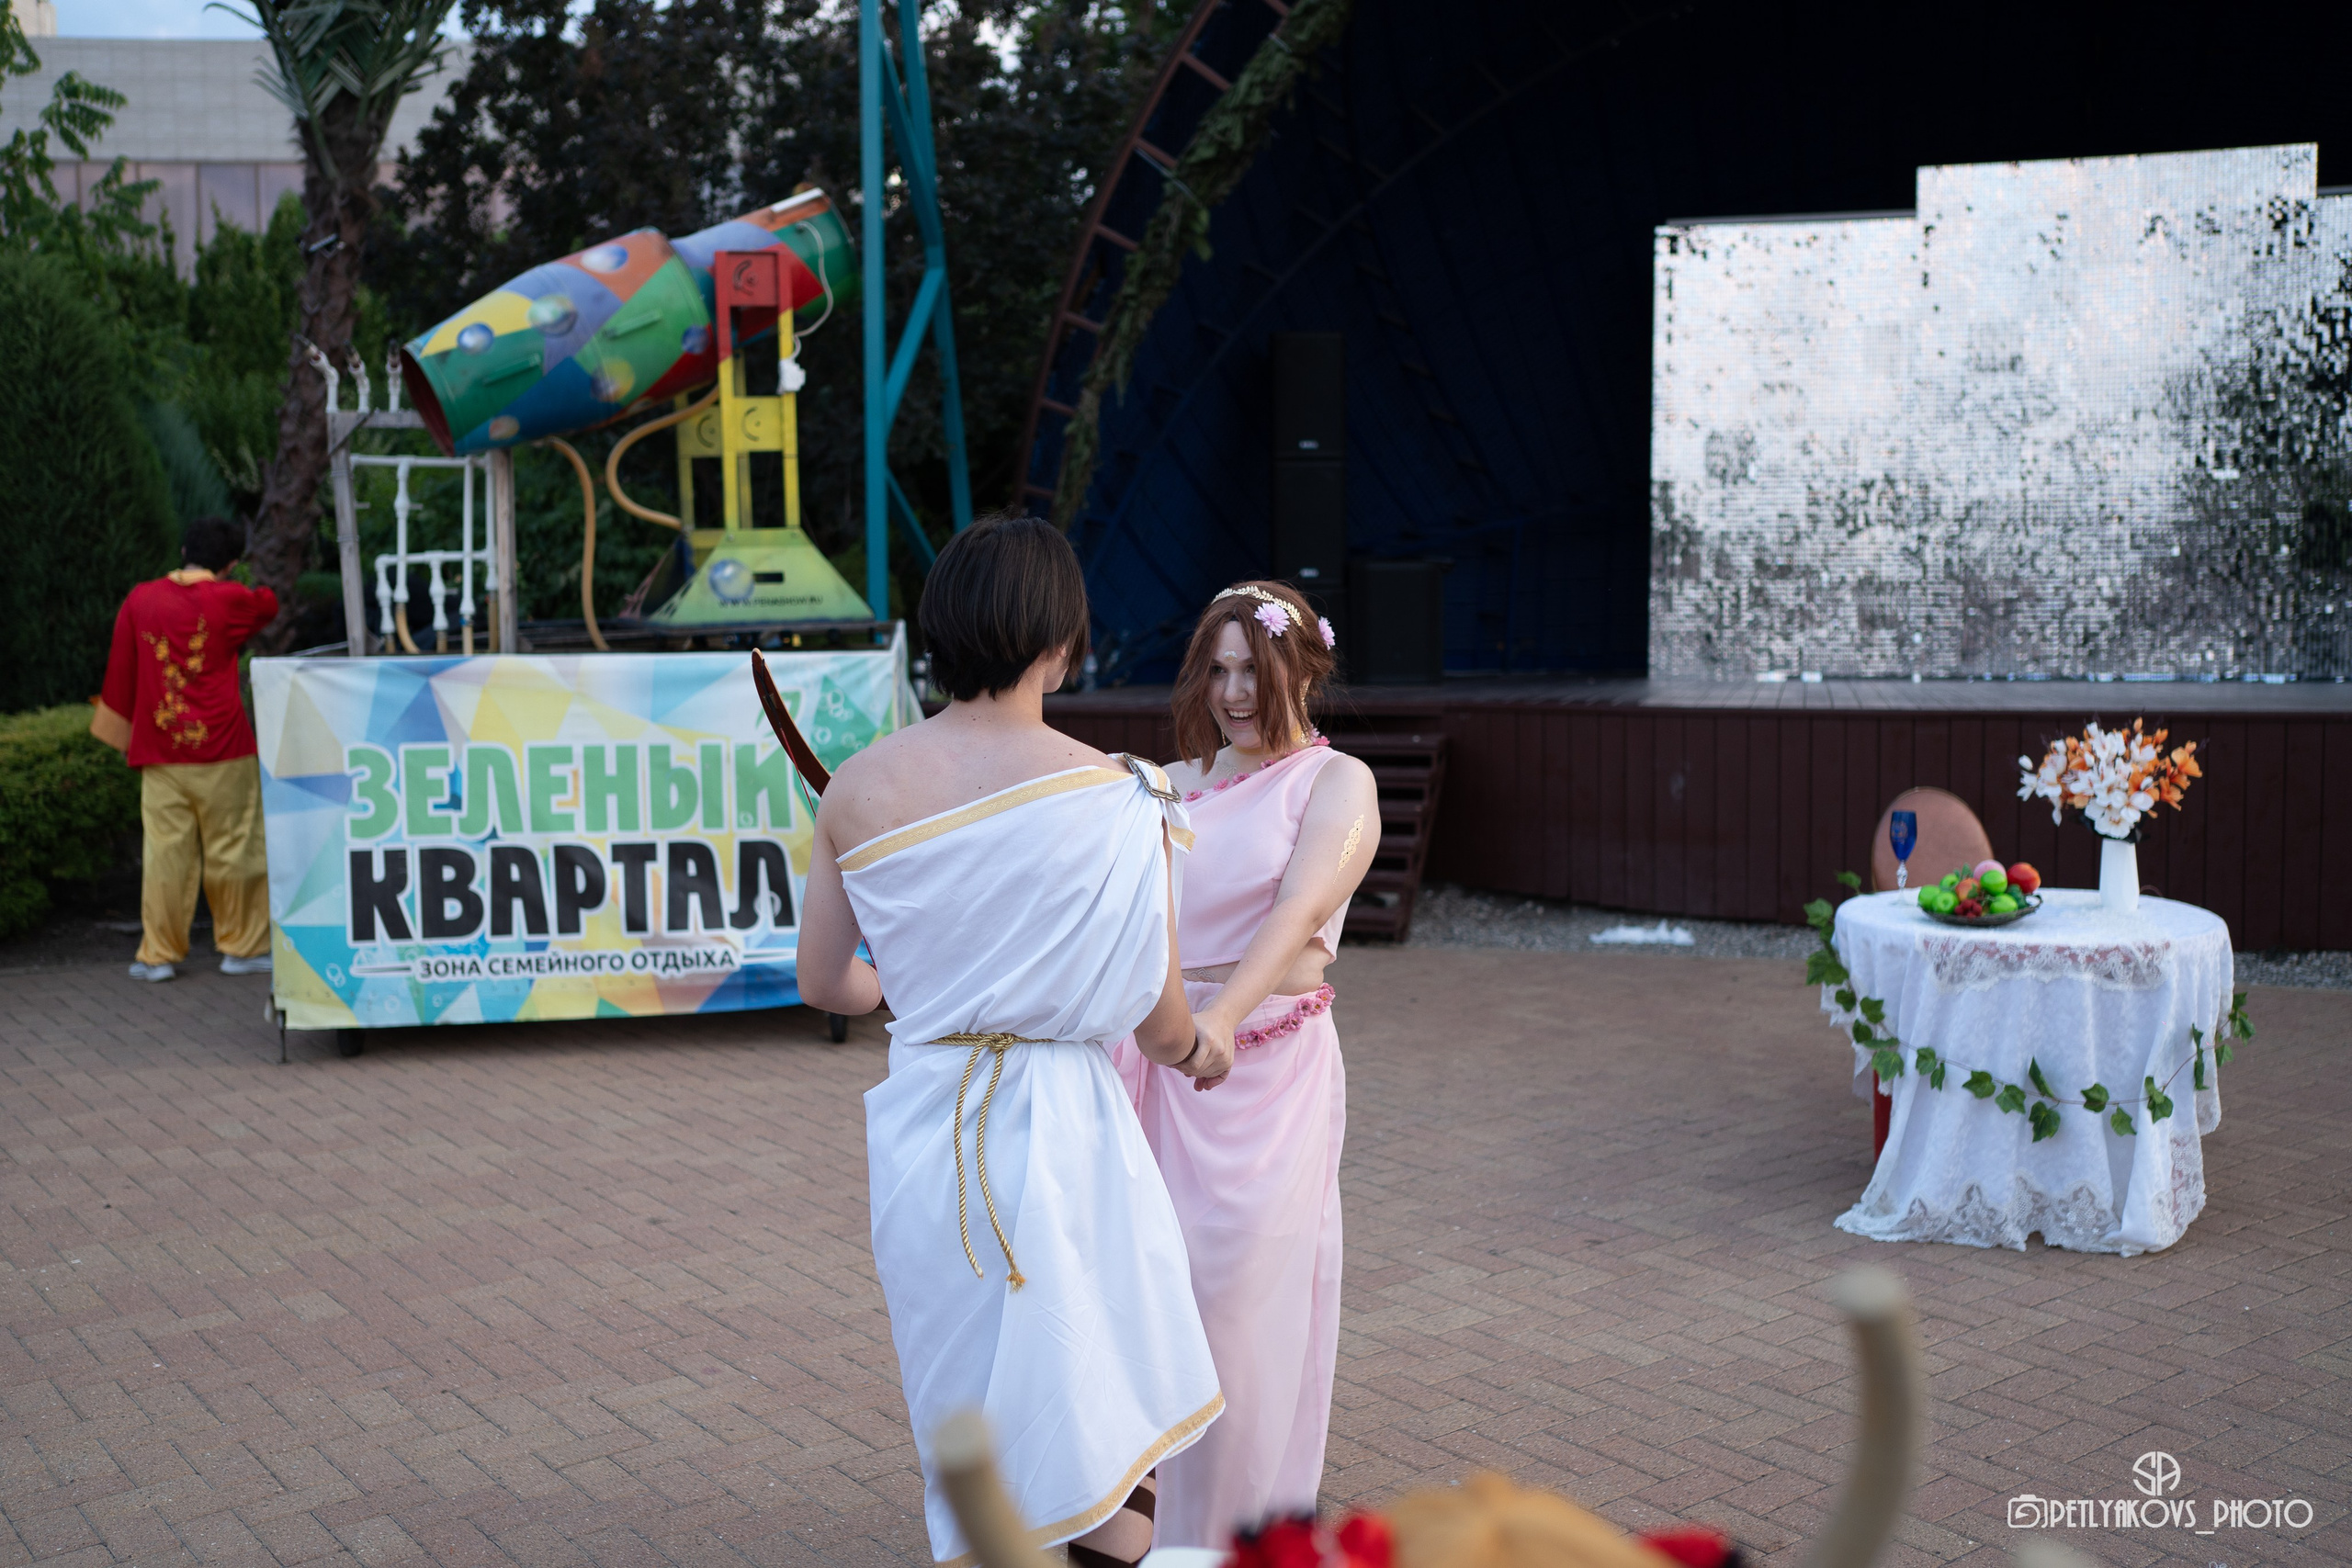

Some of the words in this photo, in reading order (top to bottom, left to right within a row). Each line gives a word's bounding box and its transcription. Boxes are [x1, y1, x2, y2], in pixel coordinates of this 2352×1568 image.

[349, 840, 796, 942] КВАРТАЛ
[420, 959, 481, 978] ЗОНА
[488, 953, 625, 976] СЕМЕЙНОГО
[631, 949, 735, 972] ОТДЫХА
